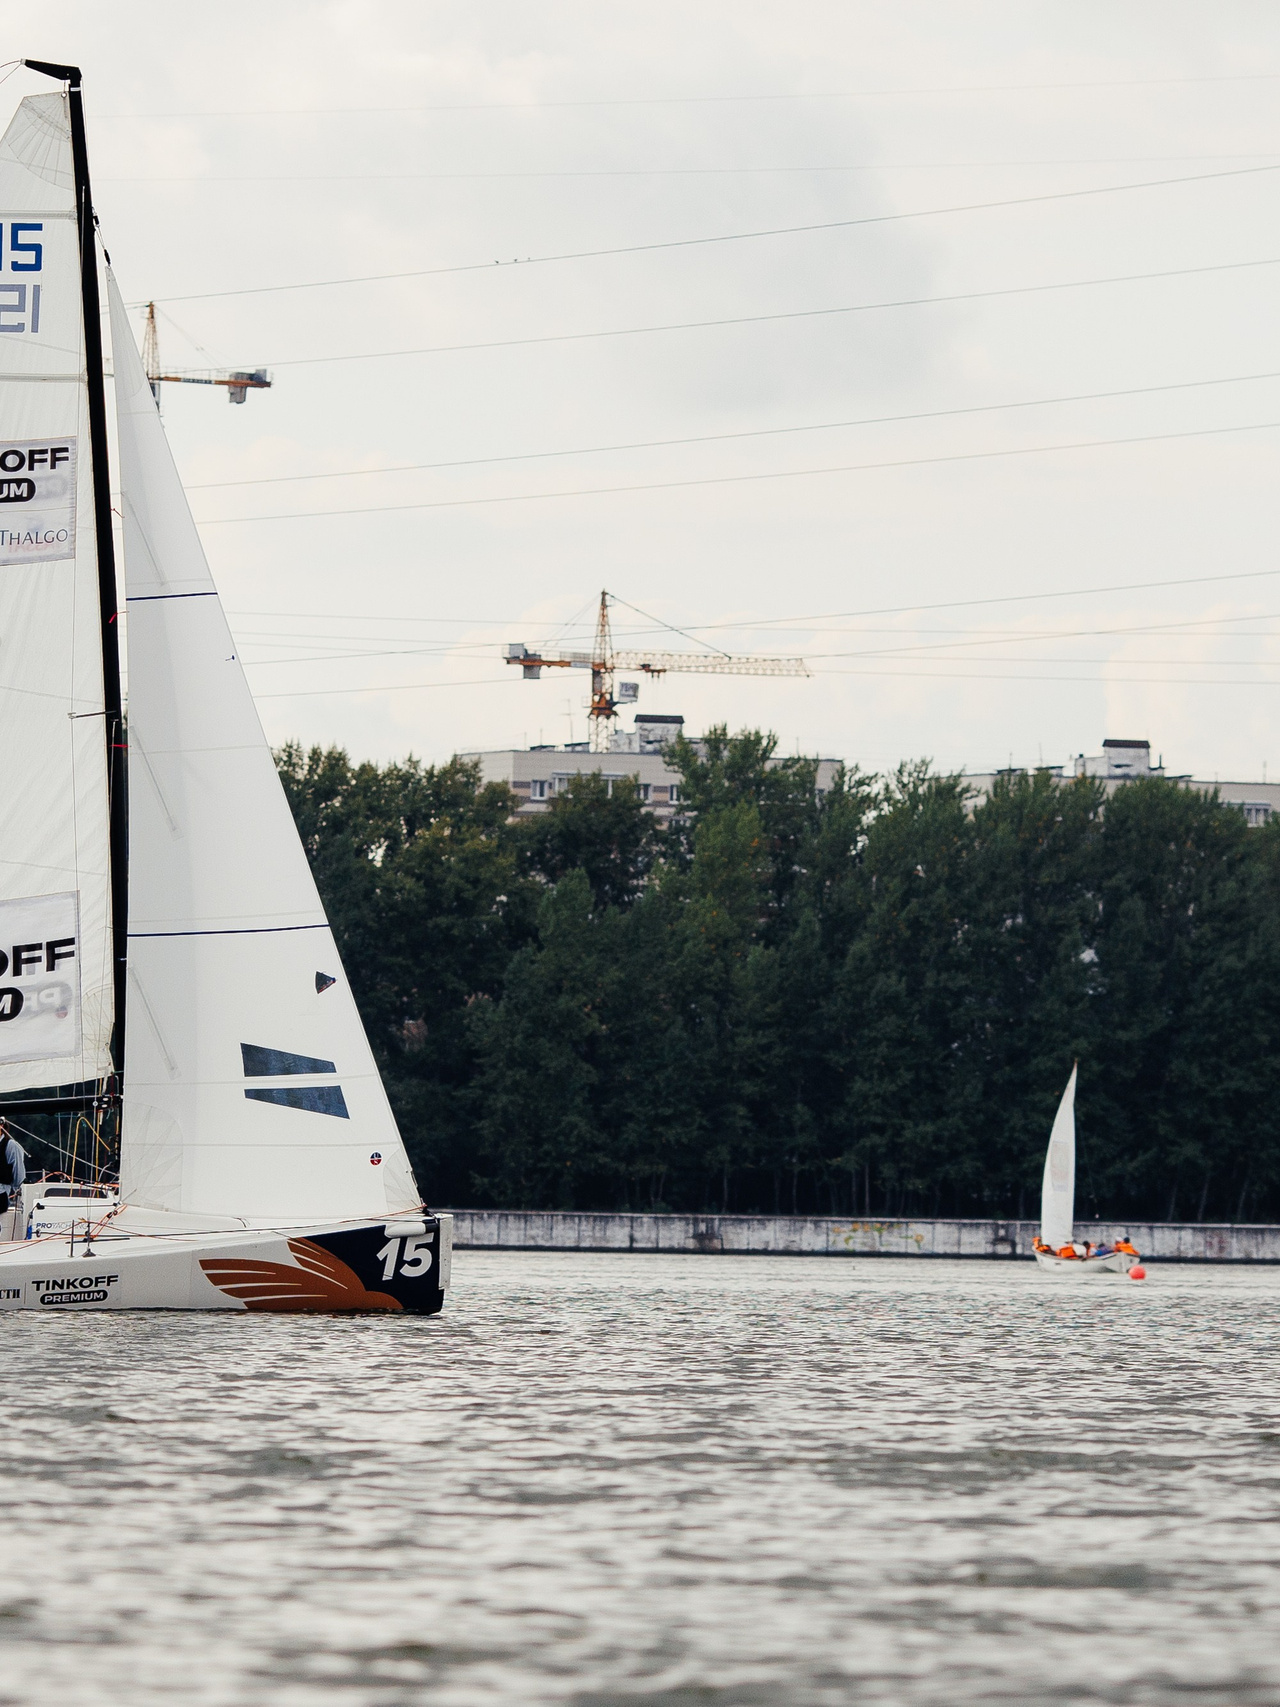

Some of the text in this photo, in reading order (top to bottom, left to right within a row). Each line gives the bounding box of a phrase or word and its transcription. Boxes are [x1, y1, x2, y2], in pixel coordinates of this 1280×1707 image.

[376, 1232, 435, 1281] 15
[31, 1274, 119, 1292] TINKOFF
[44, 1291, 104, 1303] PREMIUM
